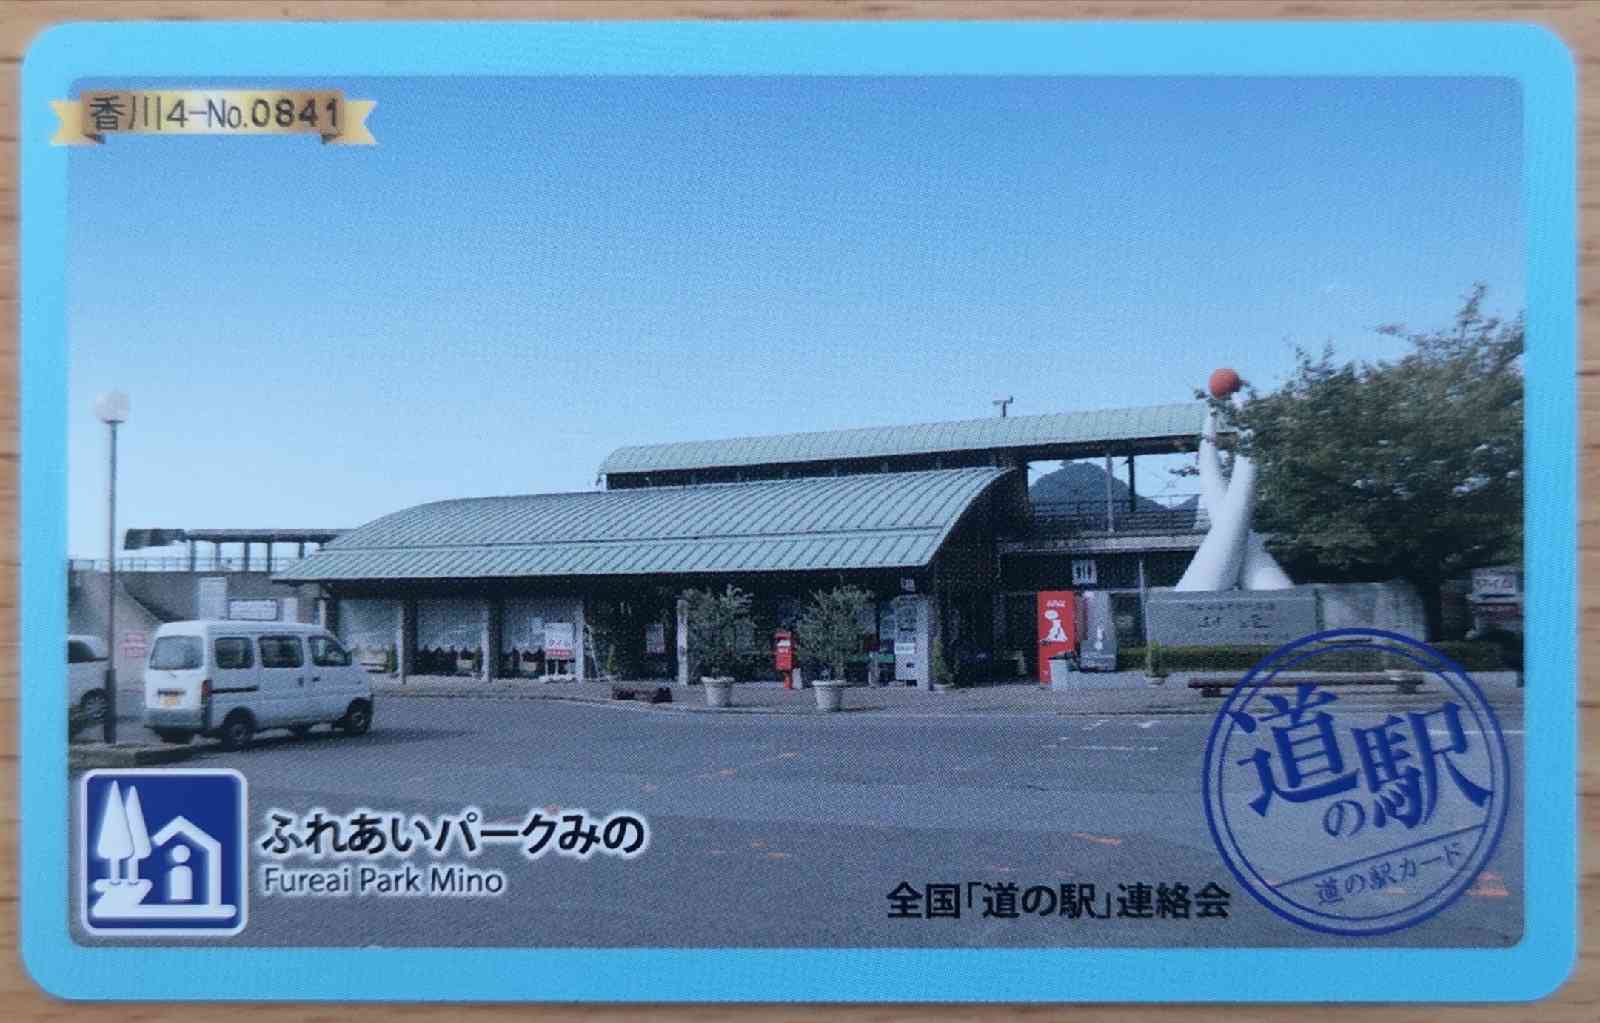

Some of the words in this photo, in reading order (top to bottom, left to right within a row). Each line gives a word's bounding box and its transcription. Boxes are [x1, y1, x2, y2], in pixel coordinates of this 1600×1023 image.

[262, 811, 646, 855] ふれあいパークみの
[263, 867, 350, 893] Fureai
[361, 867, 421, 893] Park
[431, 867, 505, 893] Mino
[1314, 842, 1466, 906] 道の駅カード
[886, 881, 1232, 920] 全国「道の駅」連絡会
